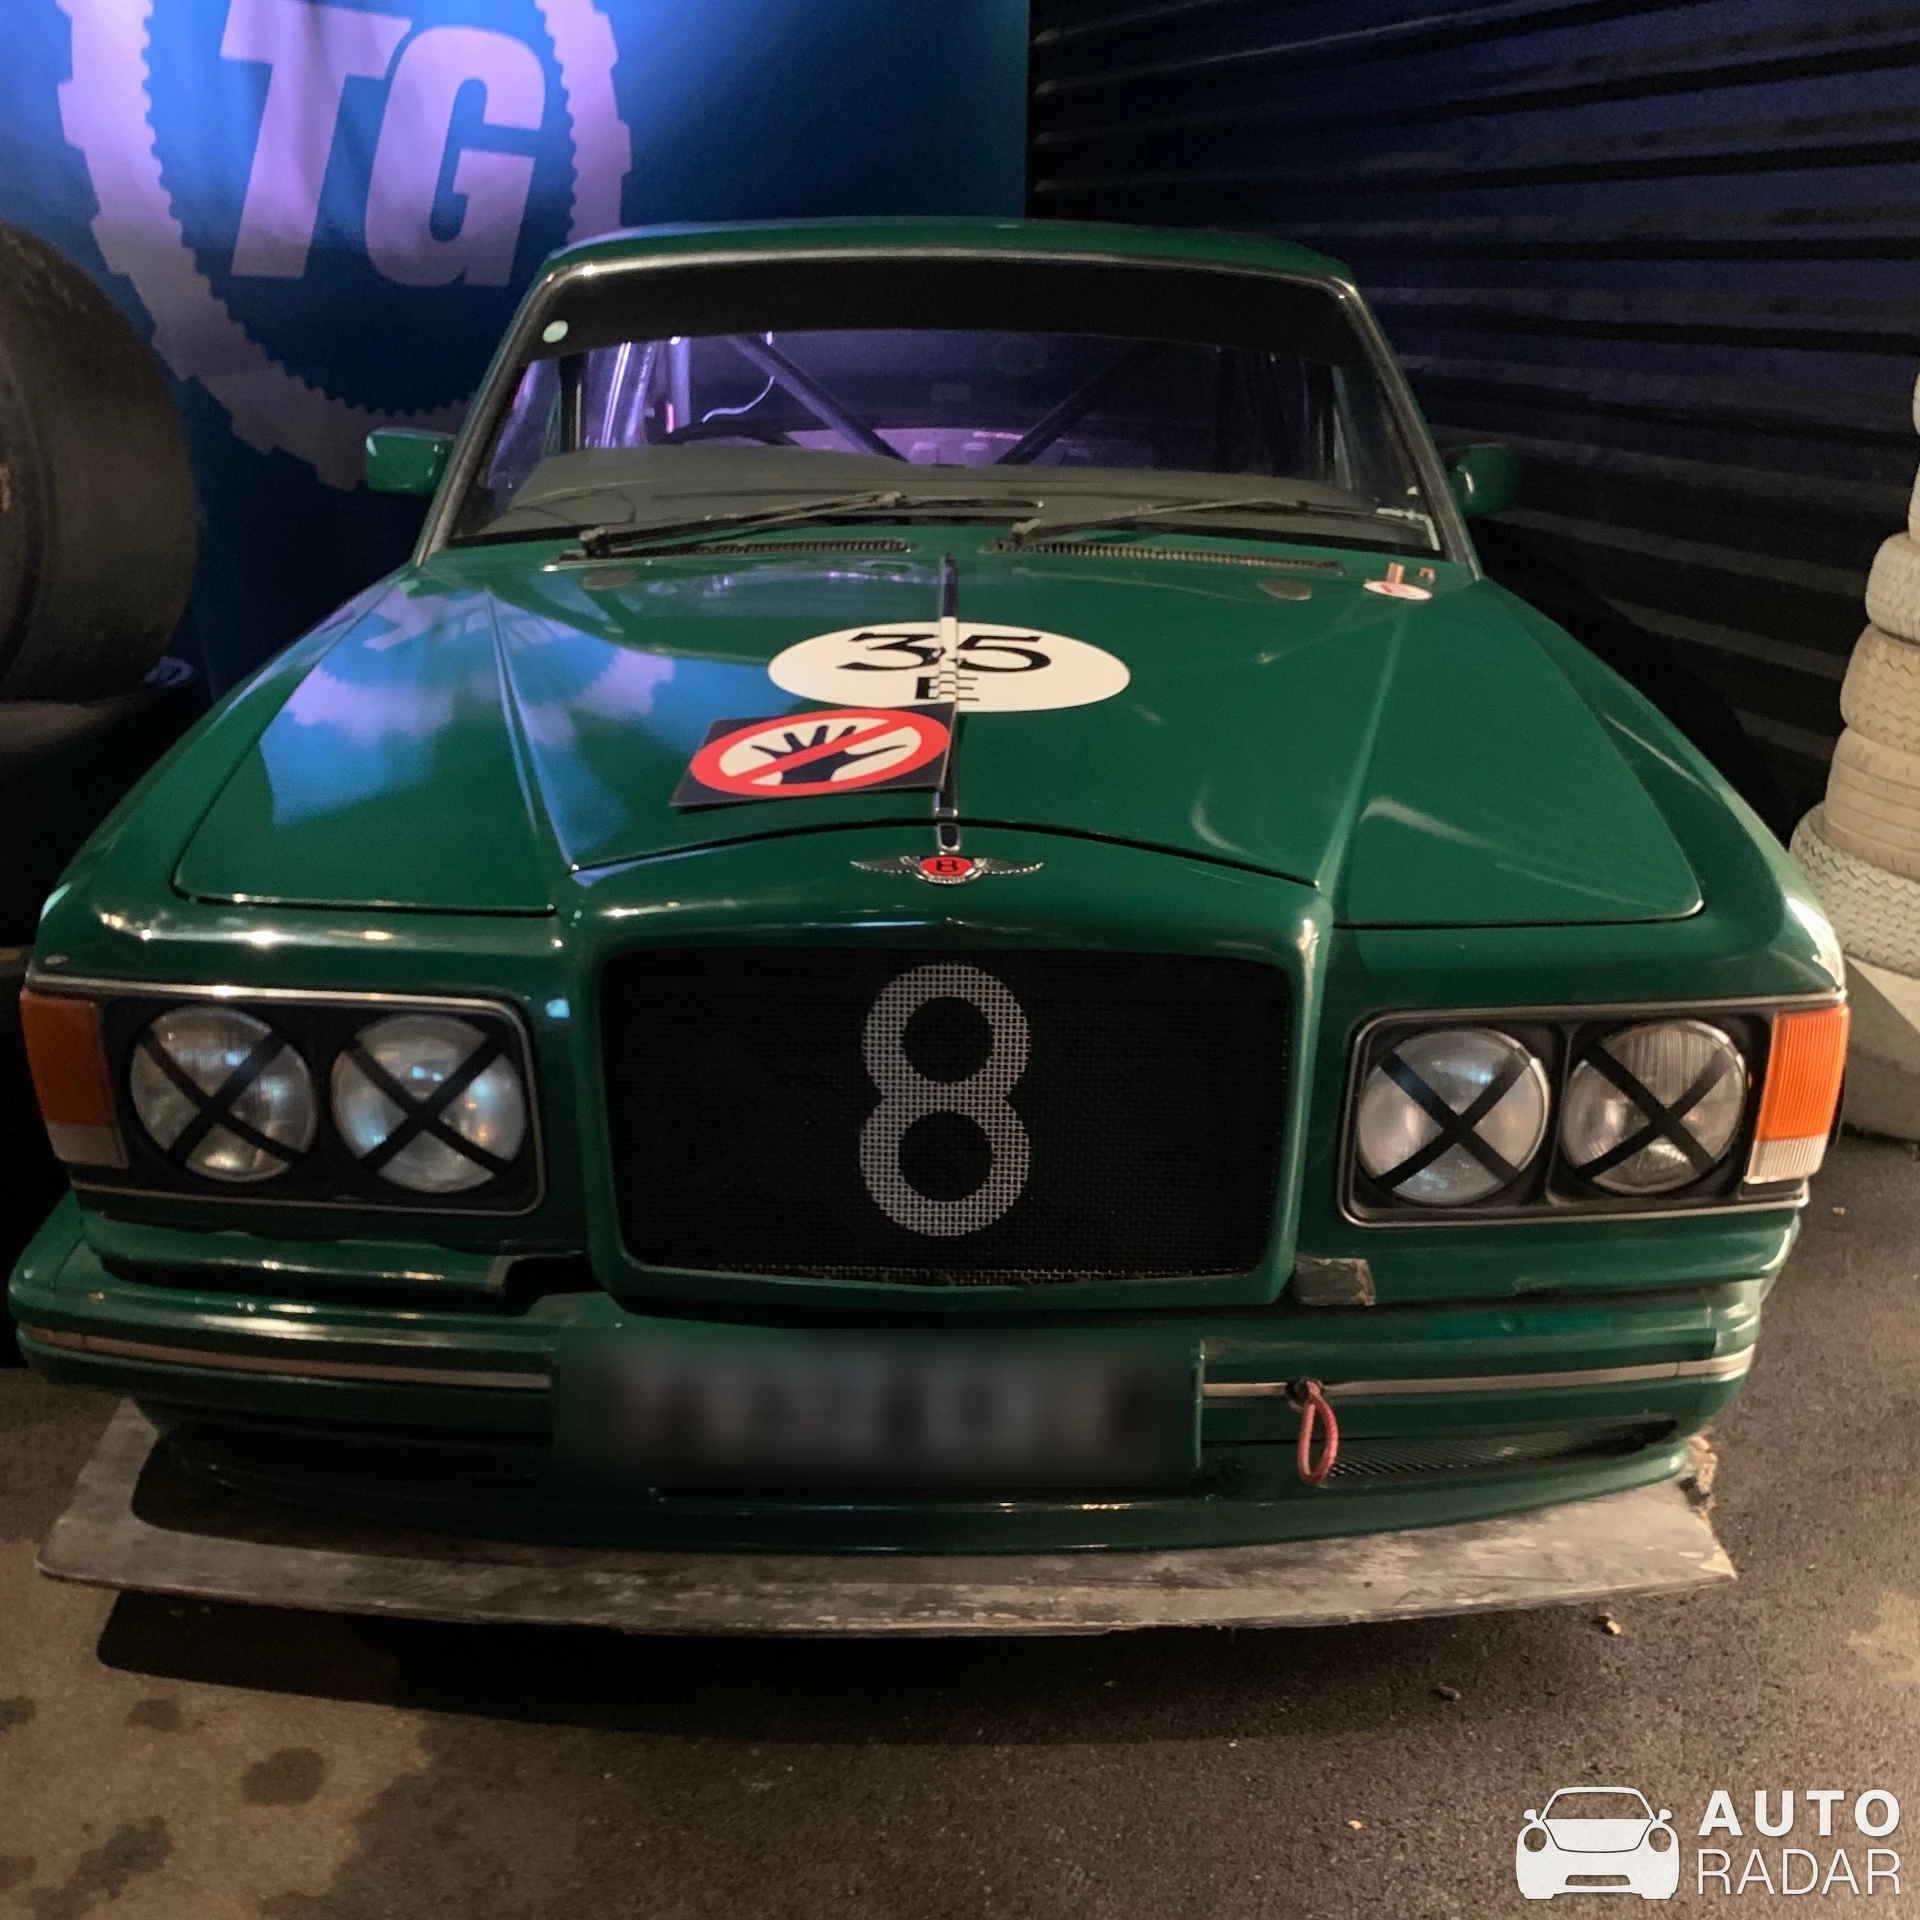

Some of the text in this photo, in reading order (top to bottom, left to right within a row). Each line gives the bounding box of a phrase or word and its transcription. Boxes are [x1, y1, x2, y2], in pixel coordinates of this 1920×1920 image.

[220, 0, 546, 287] TG
[836, 632, 1051, 673] 35
[860, 964, 1030, 1236] 8
